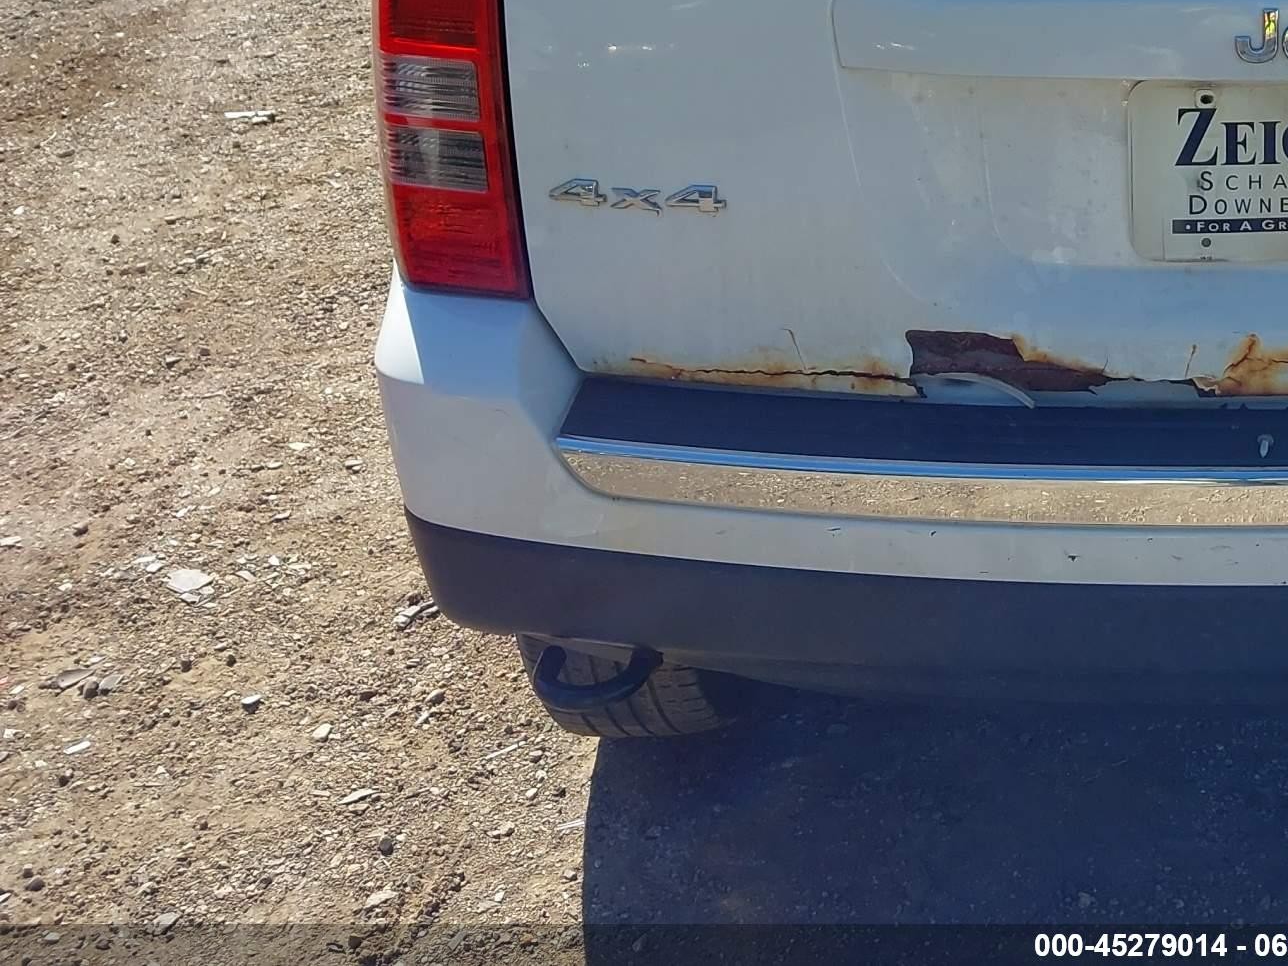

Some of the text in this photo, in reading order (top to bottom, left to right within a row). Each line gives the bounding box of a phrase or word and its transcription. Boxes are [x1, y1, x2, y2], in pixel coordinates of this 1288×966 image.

[548, 176, 728, 217] 4x4
[1196, 221, 1232, 233] FOR
[1240, 220, 1253, 232] A
